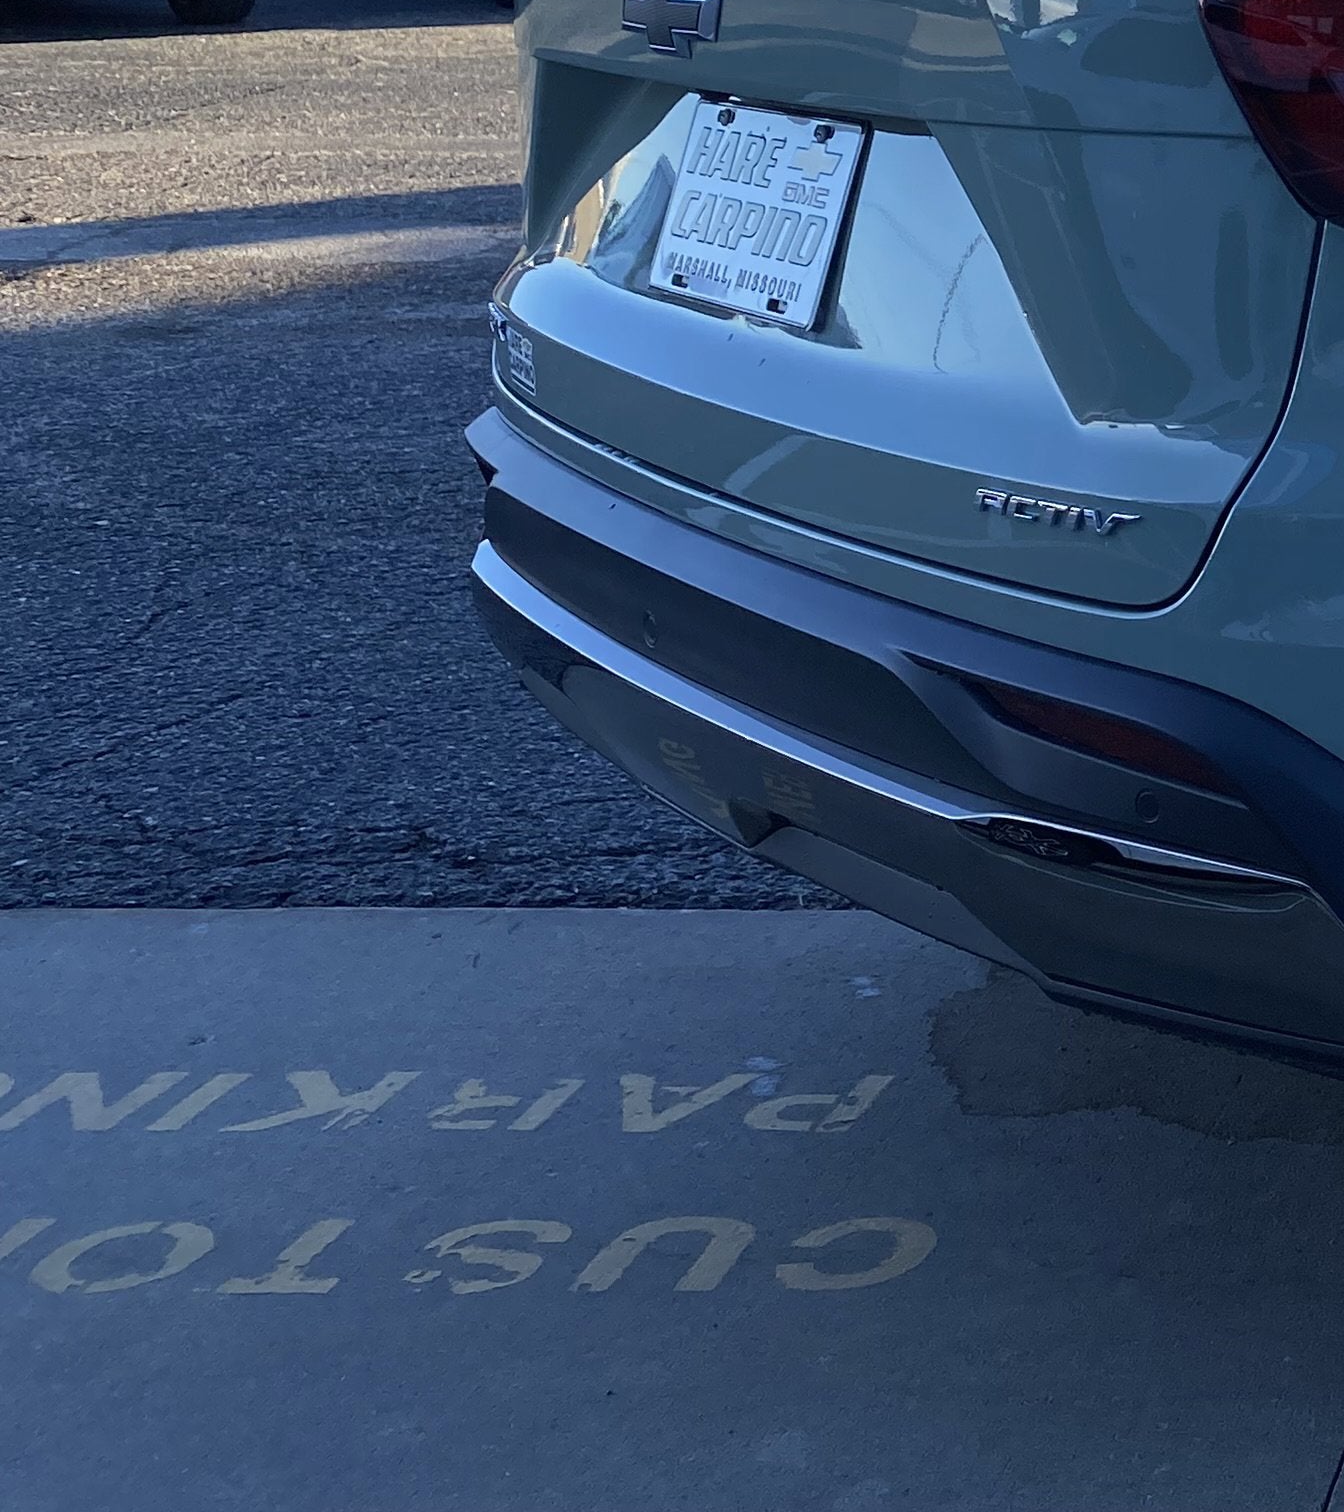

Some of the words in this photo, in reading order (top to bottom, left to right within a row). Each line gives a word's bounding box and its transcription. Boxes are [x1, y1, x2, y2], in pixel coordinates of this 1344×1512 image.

[686, 126, 787, 188] HARE
[781, 181, 830, 210] GMC
[670, 189, 828, 267] CARPINO
[668, 251, 732, 288] MARSHALL,
[734, 268, 802, 303] MISSOURI
[975, 487, 1143, 535] ACTIV
[0, 1071, 896, 1133] PARKIN
